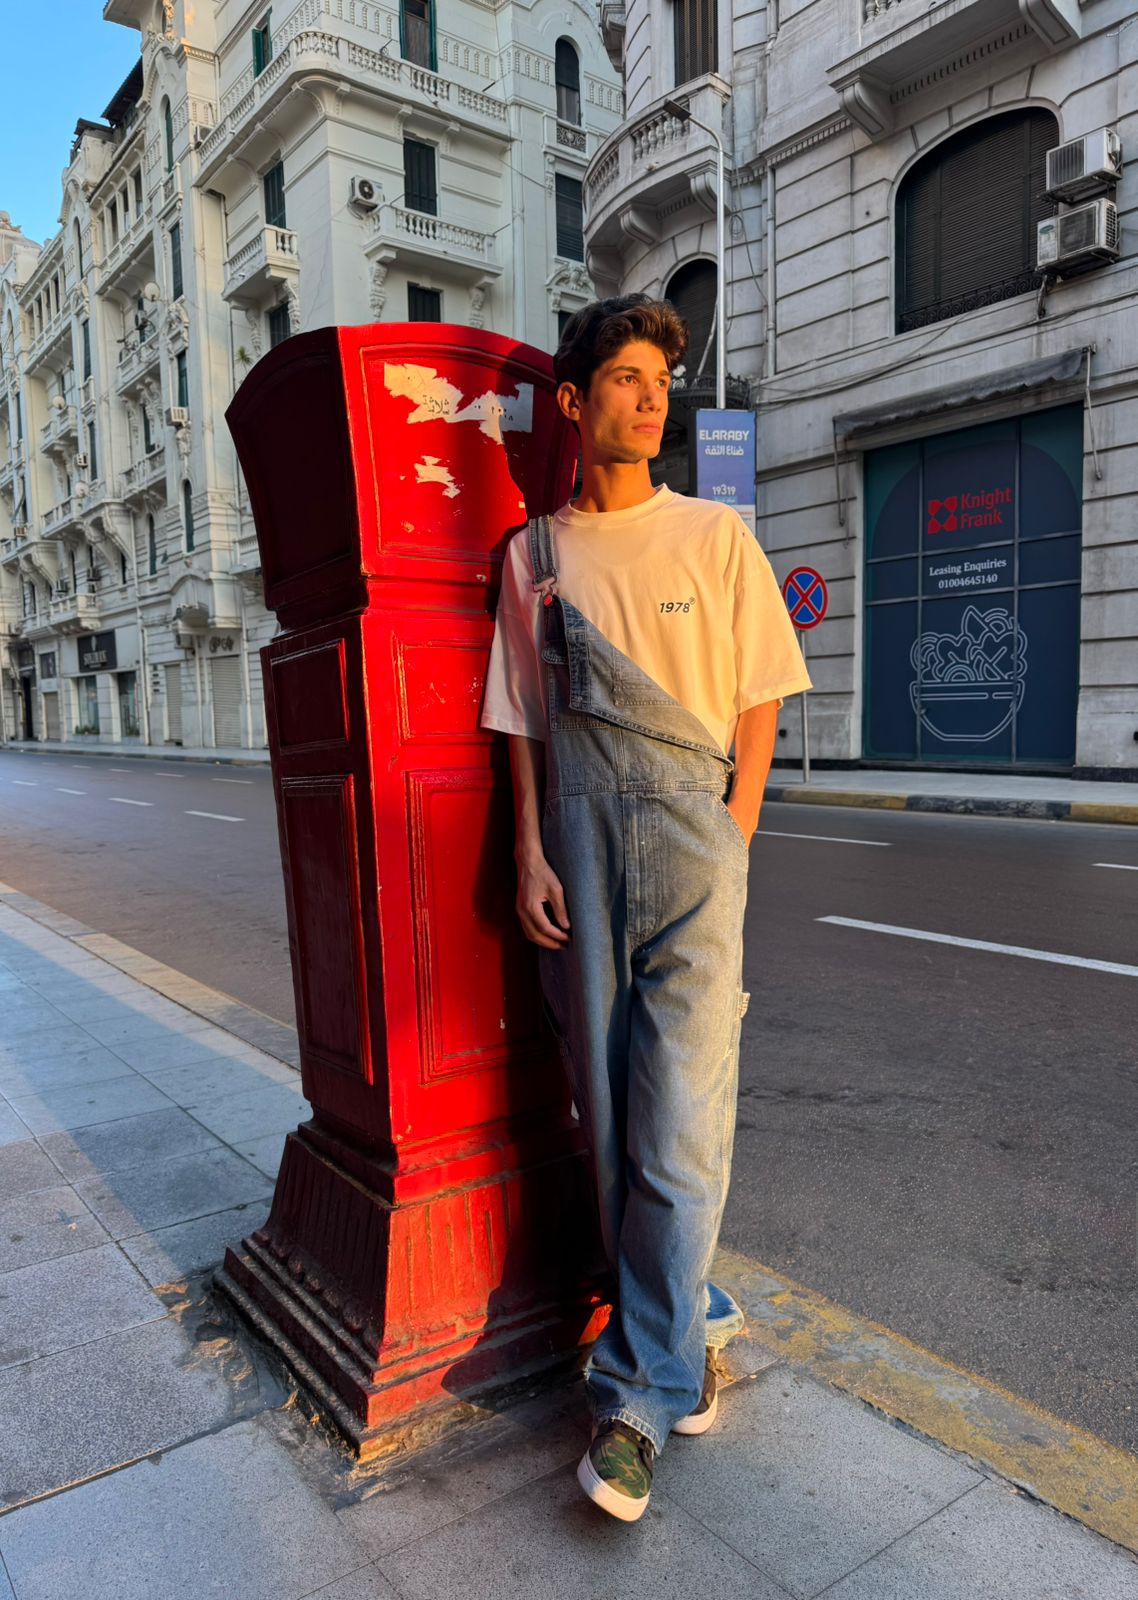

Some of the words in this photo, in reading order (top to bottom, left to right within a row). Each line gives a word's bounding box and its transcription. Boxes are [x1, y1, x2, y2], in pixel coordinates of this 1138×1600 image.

[699, 429, 750, 441] ELARABY
[704, 444, 726, 456] الثقة
[712, 483, 736, 495] 19319
[961, 488, 1012, 509] Knight
[961, 510, 1003, 528] Frank
[929, 564, 962, 576] Leasing
[963, 559, 1007, 572] Enquiries
[938, 574, 998, 589] 01004645140
